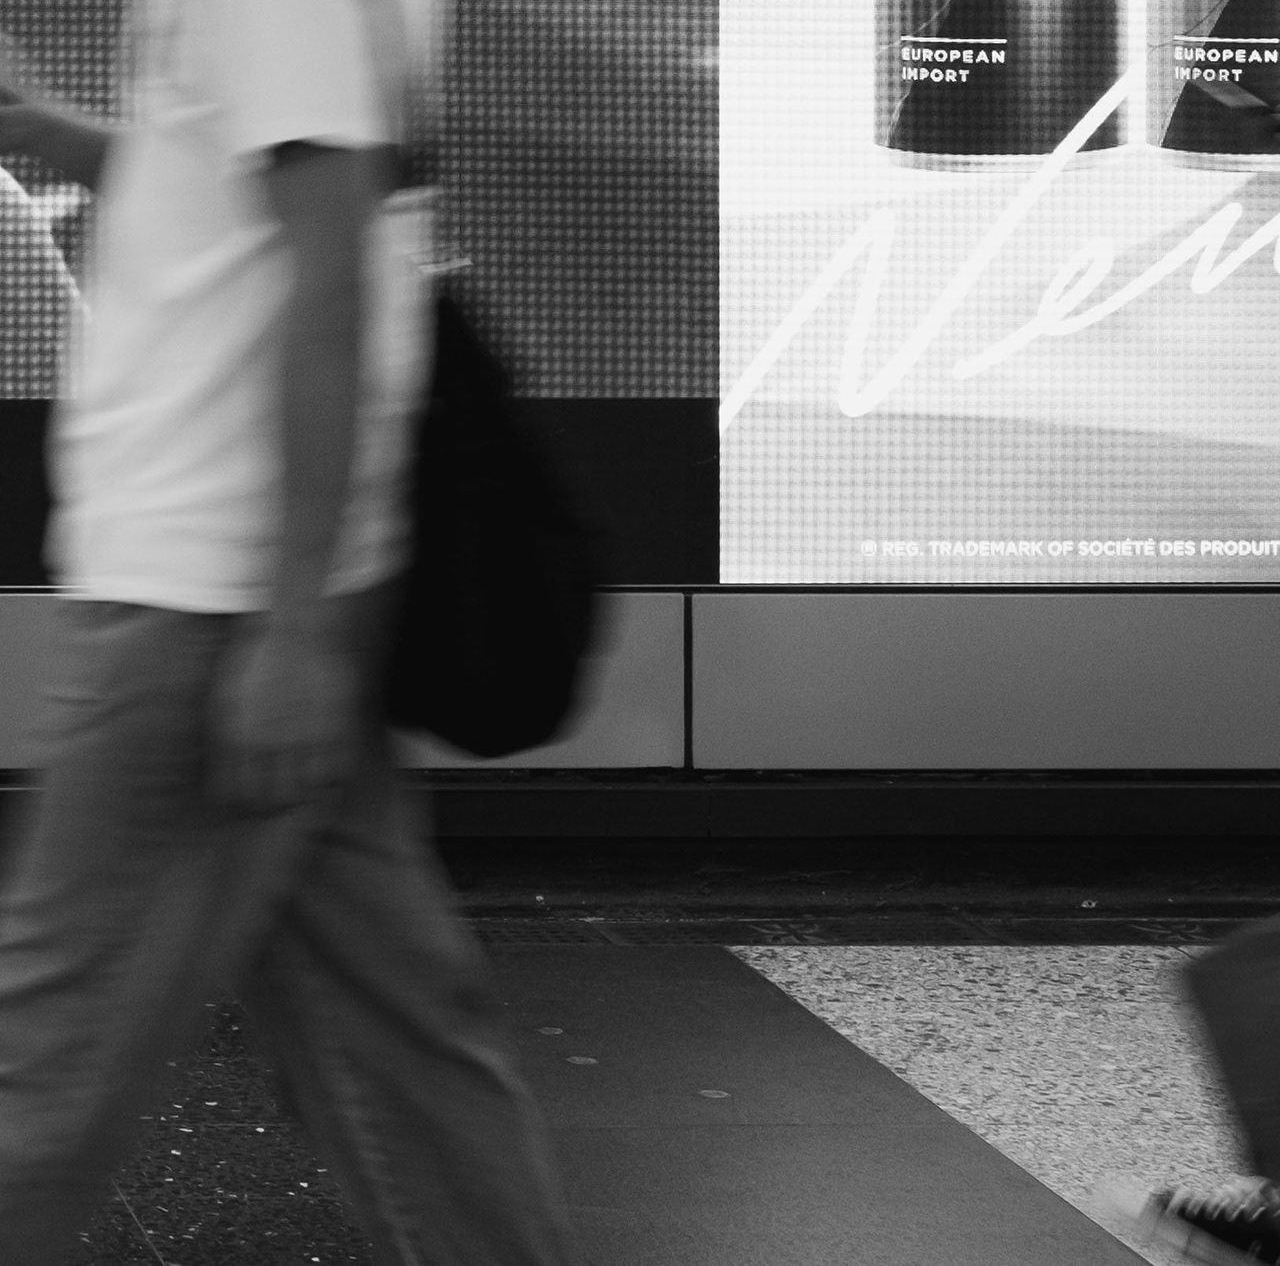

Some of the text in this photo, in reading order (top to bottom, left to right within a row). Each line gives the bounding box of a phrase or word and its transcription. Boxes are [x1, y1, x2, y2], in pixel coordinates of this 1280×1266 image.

[901, 47, 1006, 64] EUROPEAN
[1174, 45, 1279, 64] EUROPEAN
[901, 66, 970, 83] IMPORT
[1174, 65, 1243, 83] IMPORT
[881, 539, 925, 557] REG.
[928, 539, 1043, 557] TRADEMARK
[1047, 539, 1074, 557] OF
[1159, 539, 1196, 557] DES
[1200, 539, 1280, 557] PRODUIT
